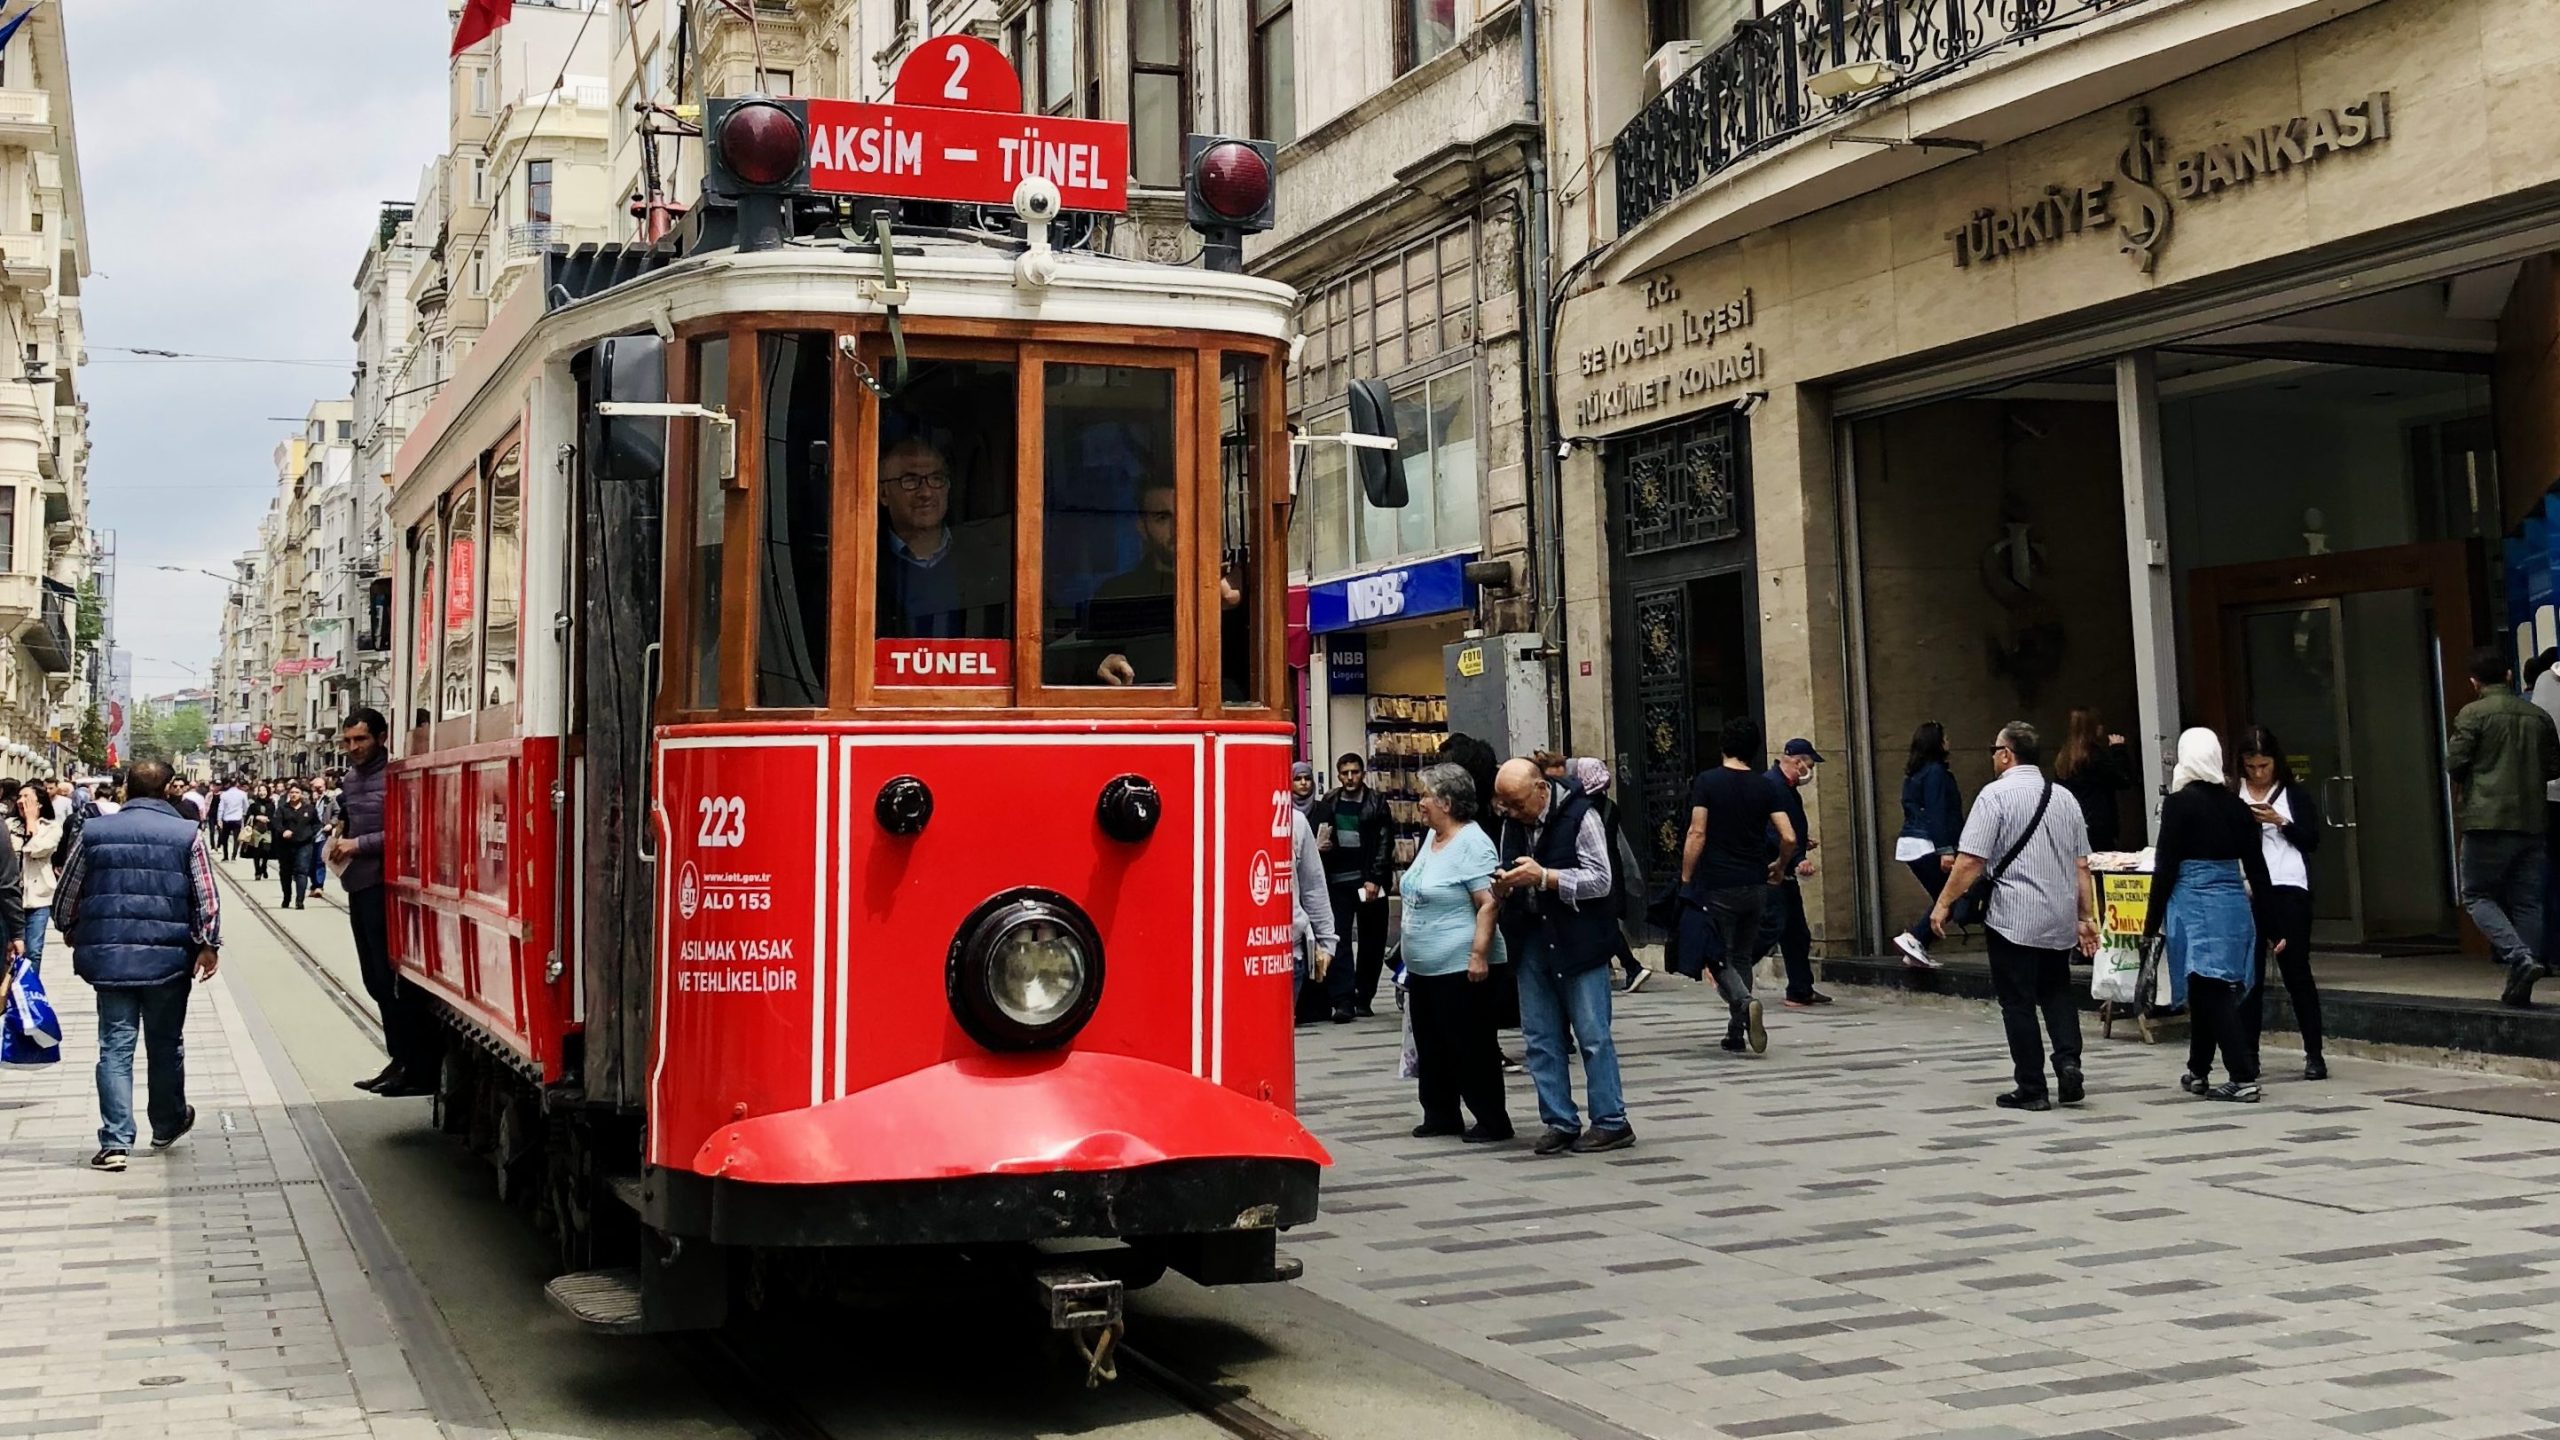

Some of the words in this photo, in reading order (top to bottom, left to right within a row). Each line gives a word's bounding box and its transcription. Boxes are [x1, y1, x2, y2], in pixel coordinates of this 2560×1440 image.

[943, 43, 970, 101] 2
[809, 116, 923, 177] AKSİM
[998, 127, 1109, 190] TÜNEL
[1944, 180, 2114, 268] TÜRKİYE
[2174, 91, 2390, 201] BANKASI
[1641, 274, 1680, 309] T.C.
[1579, 325, 1673, 377] BEYOĞLU
[1682, 286, 1753, 346] İLÇESİ
[1575, 374, 1670, 427] HÜKÜMET
[1677, 341, 1764, 399] KONAĞI
[1347, 572, 1405, 623] NBB
[890, 647, 997, 675] TÜNEL
[1332, 652, 1364, 665] NBB
[1463, 650, 1482, 663] FOTO
[697, 796, 746, 848] 223
[702, 892, 734, 910] ALO
[738, 893, 771, 910] 153
[2108, 904, 2119, 931] 3
[680, 939, 736, 961] ASILMAK
[739, 938, 794, 961] YASAK
[678, 971, 690, 992] VE
[693, 966, 797, 994] TEHLİKELİDİR
[1244, 956, 1258, 976] VE
